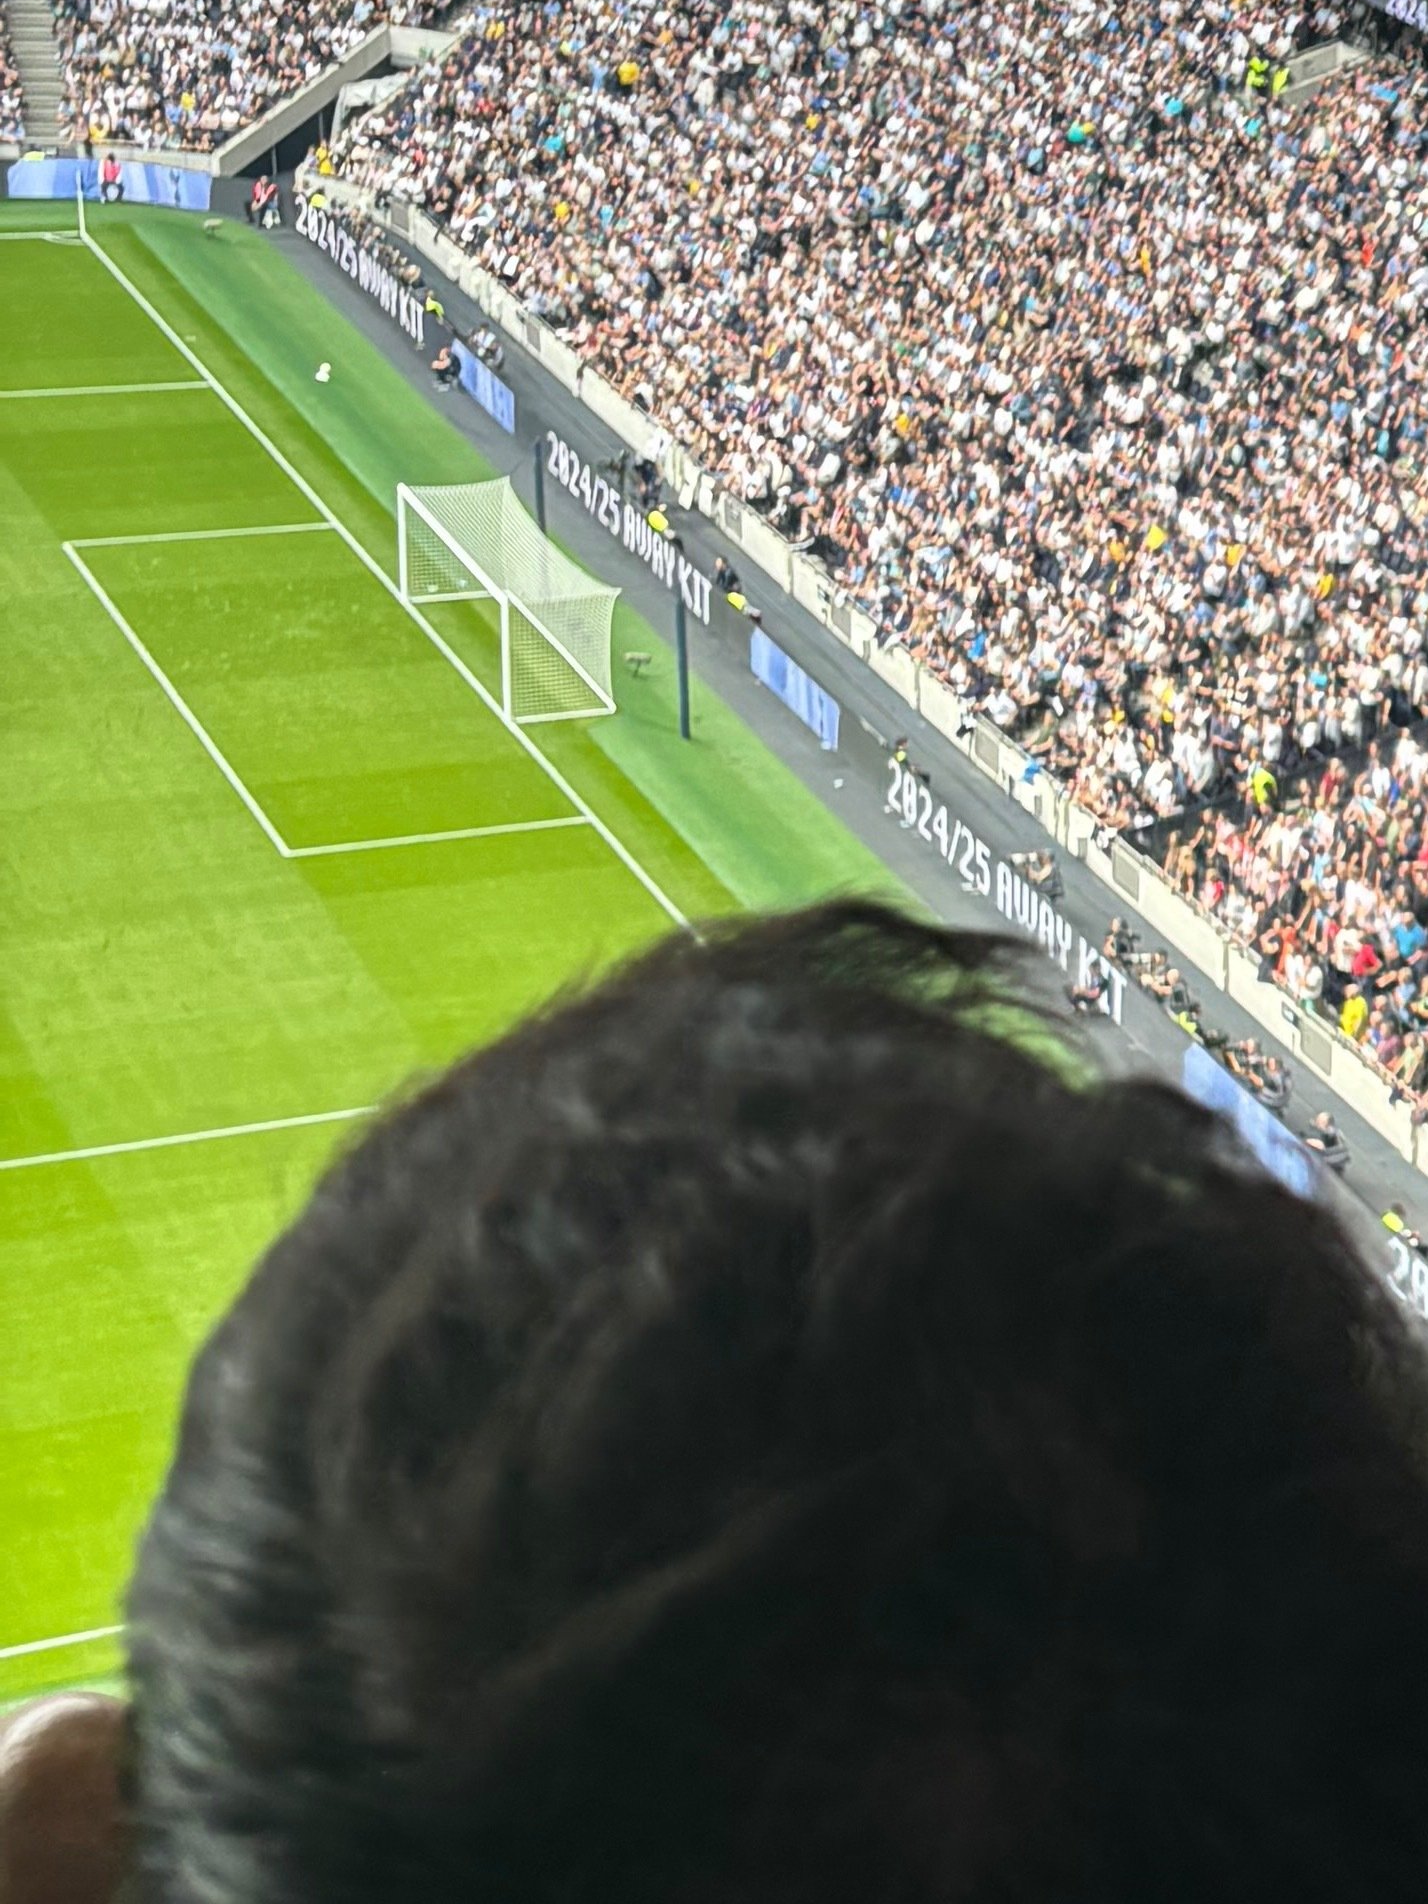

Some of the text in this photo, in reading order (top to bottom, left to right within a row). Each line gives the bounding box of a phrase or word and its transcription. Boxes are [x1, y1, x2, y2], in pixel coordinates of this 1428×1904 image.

[547, 431, 712, 625] 2024/25 AWAY KIT
[888, 763, 991, 895] 2024/25
[996, 861, 1072, 972] AWAY
